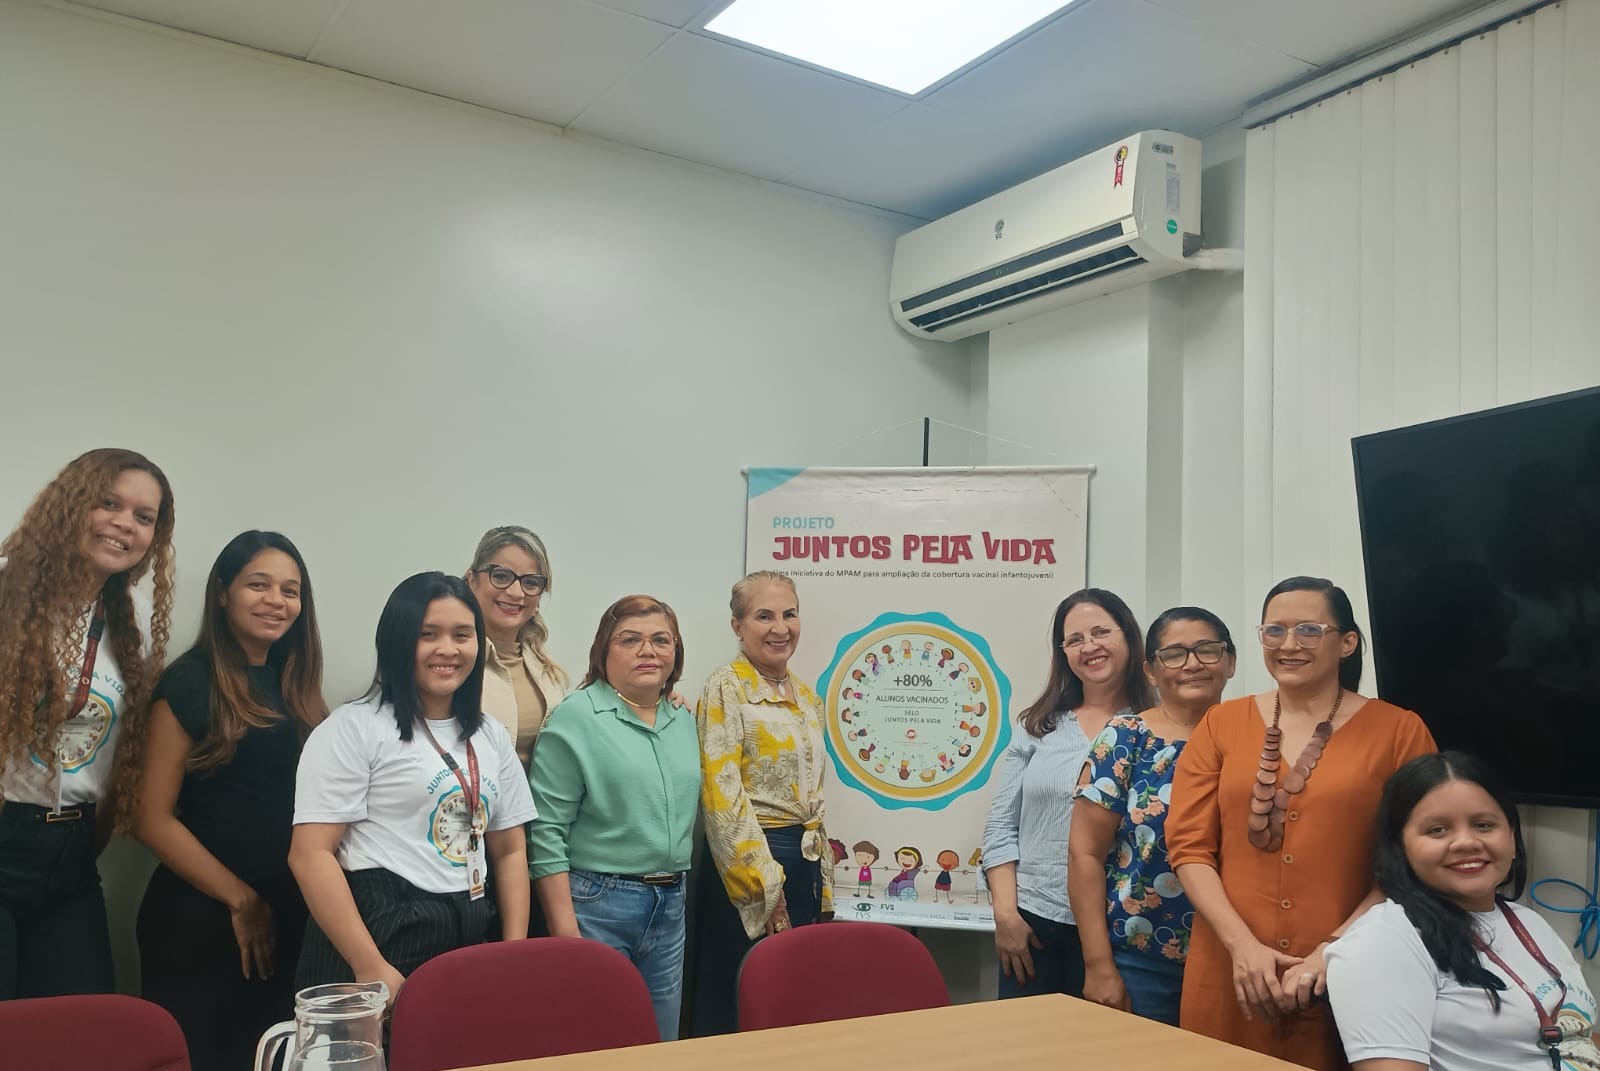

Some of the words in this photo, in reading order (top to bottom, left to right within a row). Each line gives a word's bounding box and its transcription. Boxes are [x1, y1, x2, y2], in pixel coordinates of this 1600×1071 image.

[773, 517, 835, 529] PROJETO
[772, 535, 891, 562] JUNTOS
[903, 534, 974, 564] PELA
[981, 531, 1057, 565] VIDA
[790, 569, 823, 577] iniciativa
[824, 569, 835, 577] do
[836, 570, 861, 578] MPAM
[862, 570, 880, 581] para
[881, 570, 920, 581] ampliação
[932, 571, 970, 579] cobertura
[971, 571, 999, 579] vacinal
[1000, 571, 1054, 581] infantojuvenil
[893, 674, 933, 688] +80%
[876, 695, 906, 704] ALUNOS
[906, 696, 949, 705] VACINADOS
[856, 911, 872, 920] FVS
[880, 903, 895, 911] FVS
